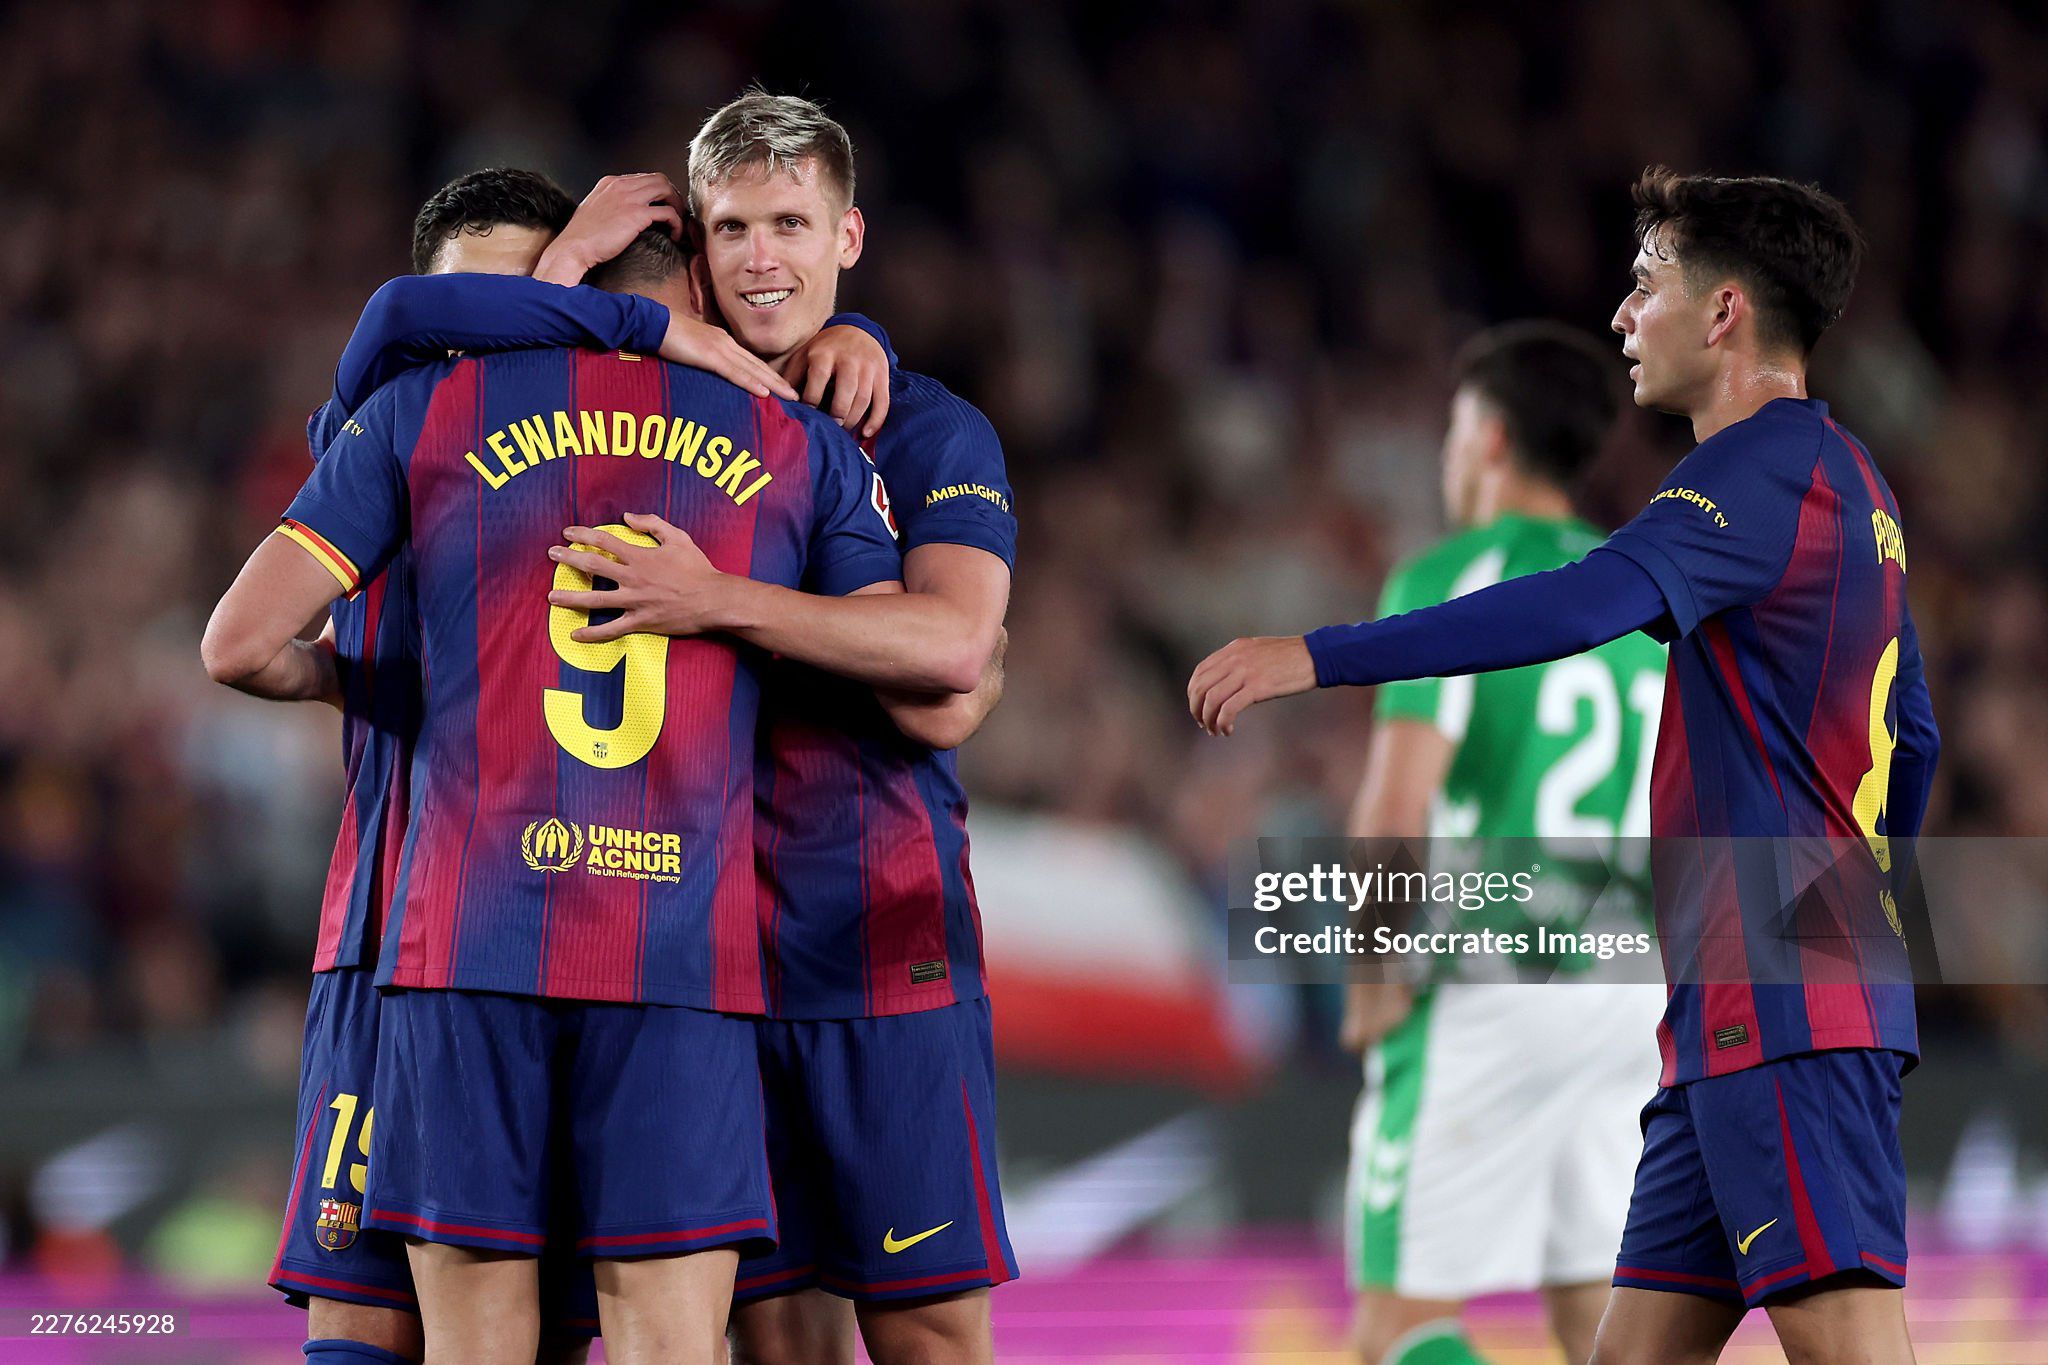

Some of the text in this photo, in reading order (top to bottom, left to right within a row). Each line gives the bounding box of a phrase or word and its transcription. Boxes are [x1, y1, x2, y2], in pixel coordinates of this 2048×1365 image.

[465, 410, 773, 507] LEWANDOWSKI
[925, 483, 1002, 508] AMBILIGHT
[1714, 511, 1729, 528] tv
[1871, 508, 1906, 575] PEDRI
[543, 523, 669, 769] 9
[1534, 652, 1666, 877] 21
[588, 824, 681, 854] UNHCR
[586, 846, 681, 874] ACNUR
[587, 866, 681, 884] The UN Refugee Agency
